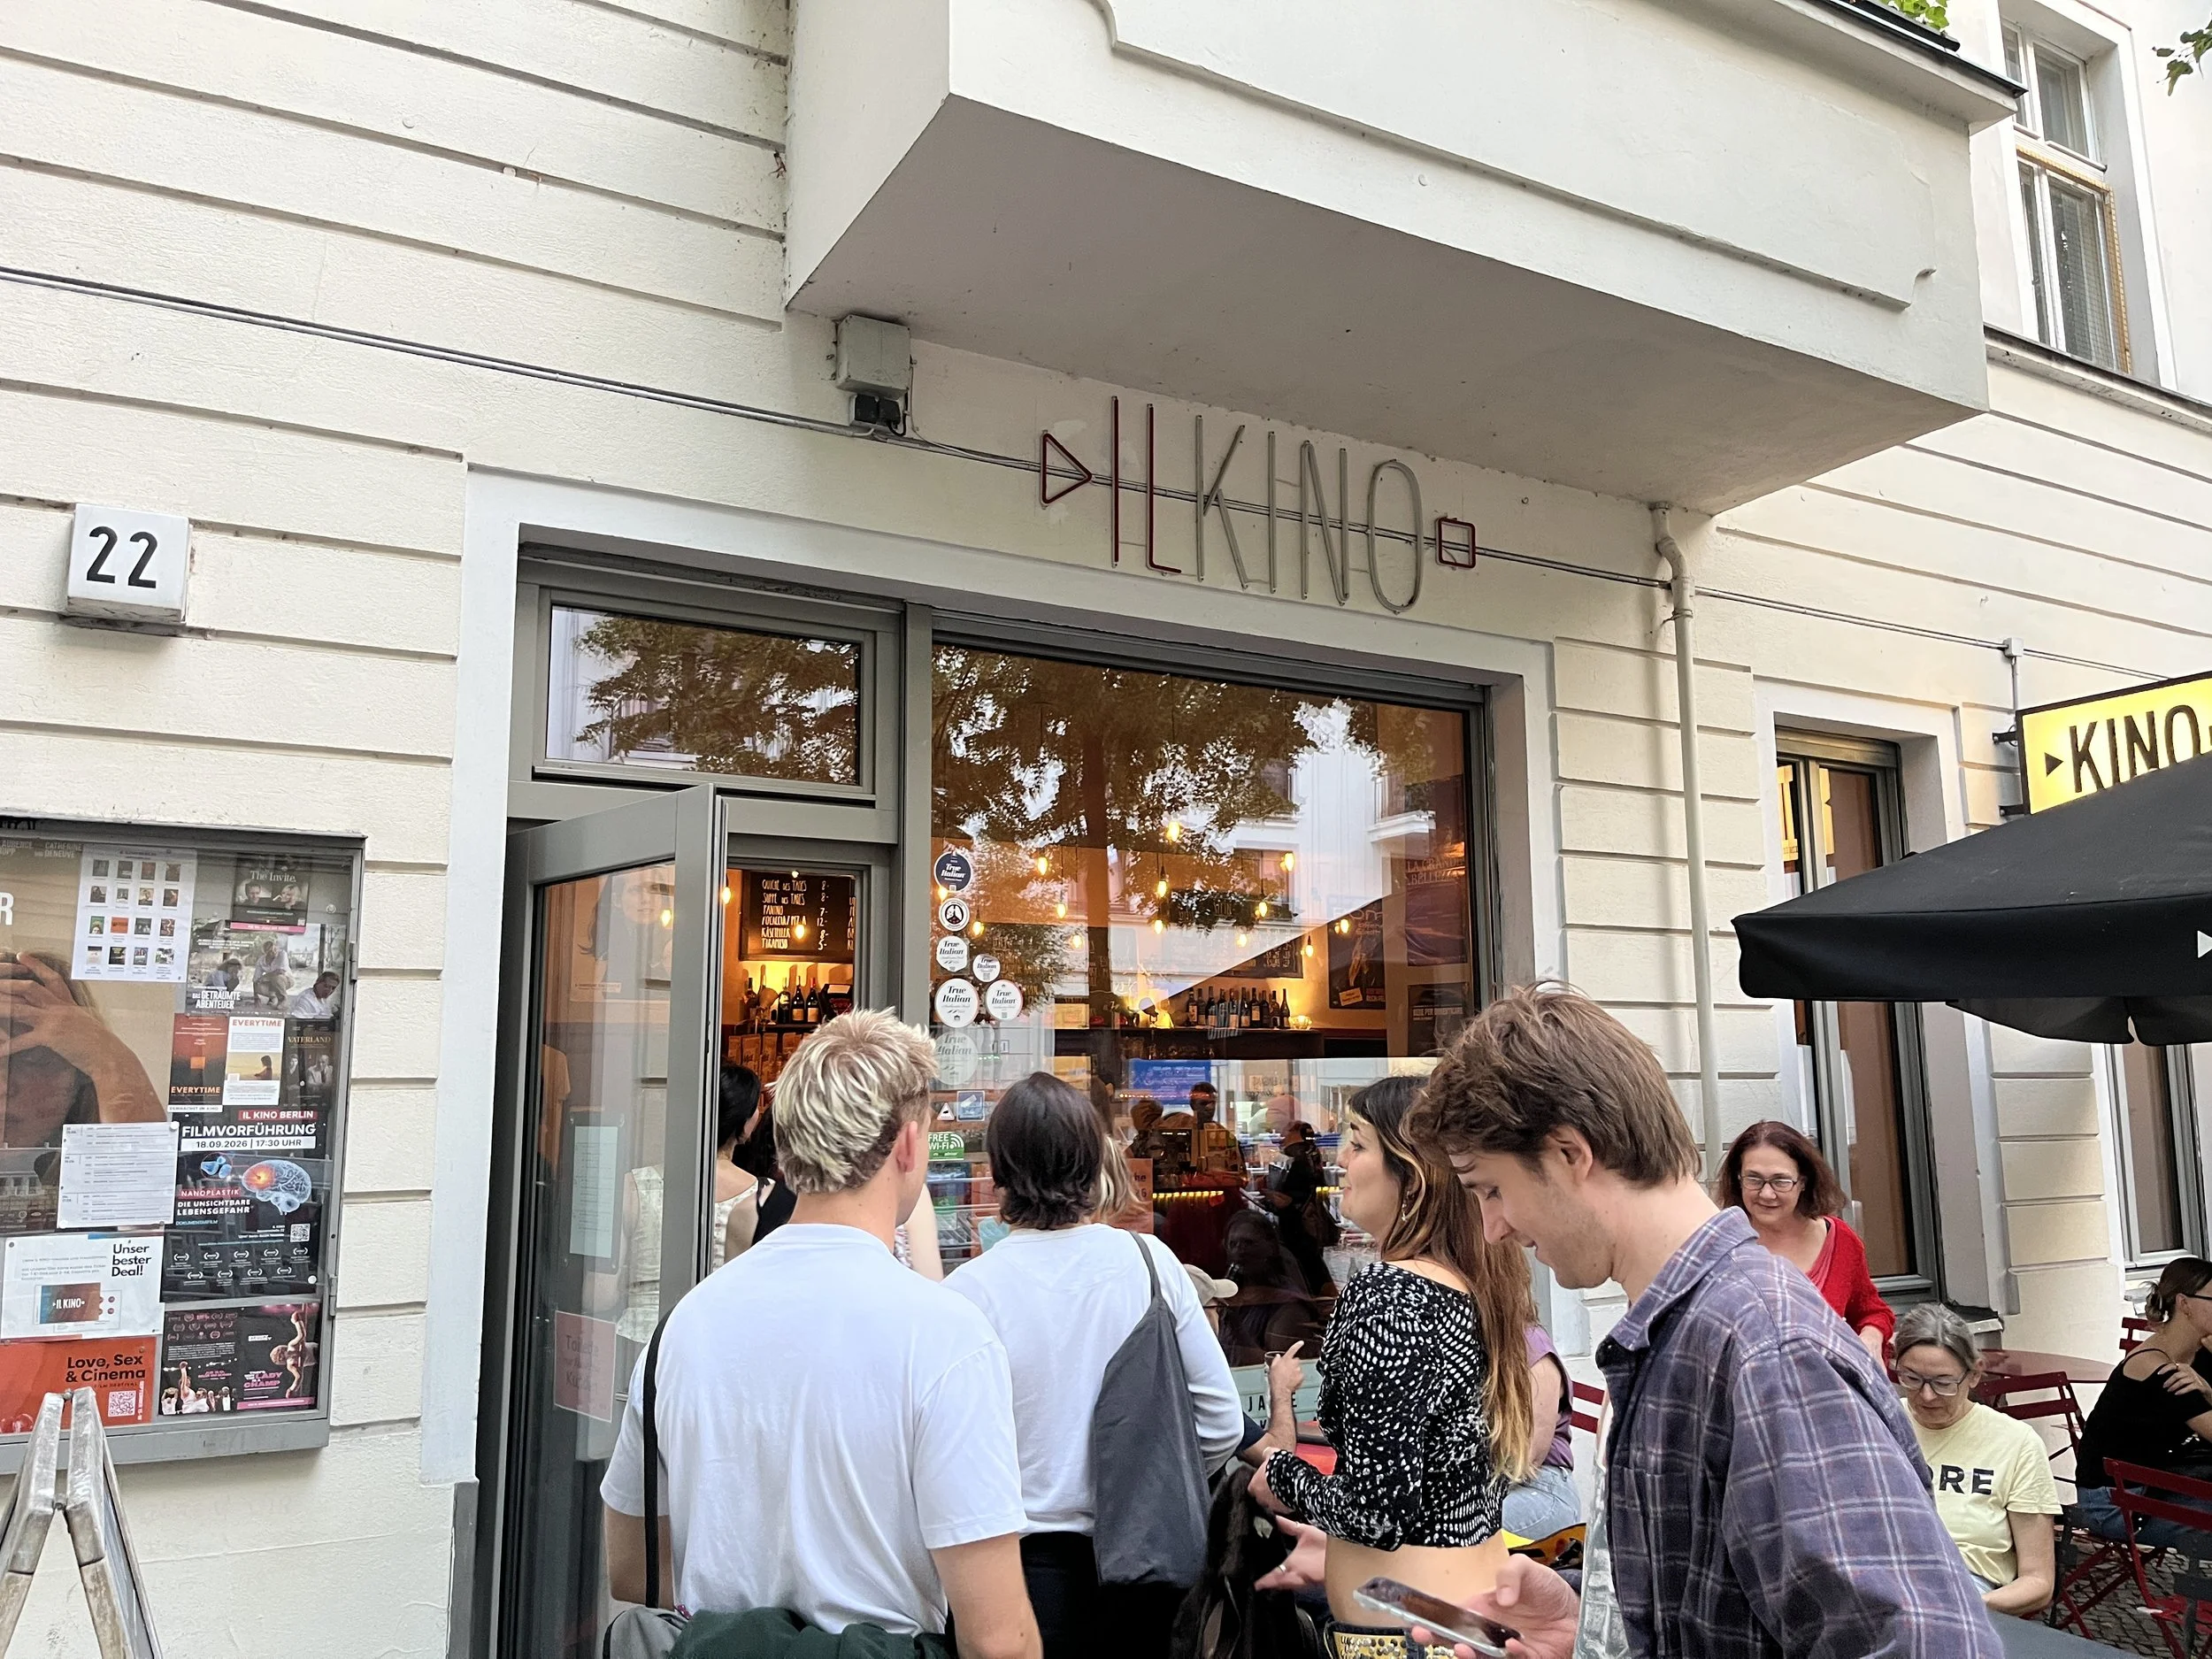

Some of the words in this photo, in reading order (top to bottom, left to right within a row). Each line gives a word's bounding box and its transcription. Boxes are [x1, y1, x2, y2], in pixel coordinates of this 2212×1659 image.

[1111, 396, 1182, 575] IL
[1196, 415, 1424, 613] KINO
[87, 526, 157, 588] 22
[2069, 704, 2203, 793] KINO
[945, 863, 962, 872] True
[250, 870, 266, 880] The
[941, 869, 966, 879] Italian
[196, 999, 234, 1010] ABENTEUER
[944, 1033, 967, 1044] True
[279, 1110, 314, 1119] BERLIN
[181, 1123, 317, 1137] FILMVORFÜHRUNG
[196, 1140, 248, 1148] 18.09.2026
[928, 1141, 949, 1150] WI-FI
[180, 1188, 240, 1197] NANOPLASTIK
[193, 1199, 250, 1208] UNSICHTBARE
[177, 1207, 250, 1216] LEBENSGEFAHR
[112, 1243, 150, 1254] Unser
[111, 1255, 152, 1265] bester
[111, 1265, 143, 1277] Deal!
[56, 1299, 62, 1310] IL
[63, 1297, 81, 1309] KINO
[67, 1356, 110, 1369] Love,
[113, 1354, 143, 1366] Sex
[65, 1371, 78, 1382] &
[81, 1369, 146, 1381] Cinema
[1927, 1464, 1993, 1495] RE
